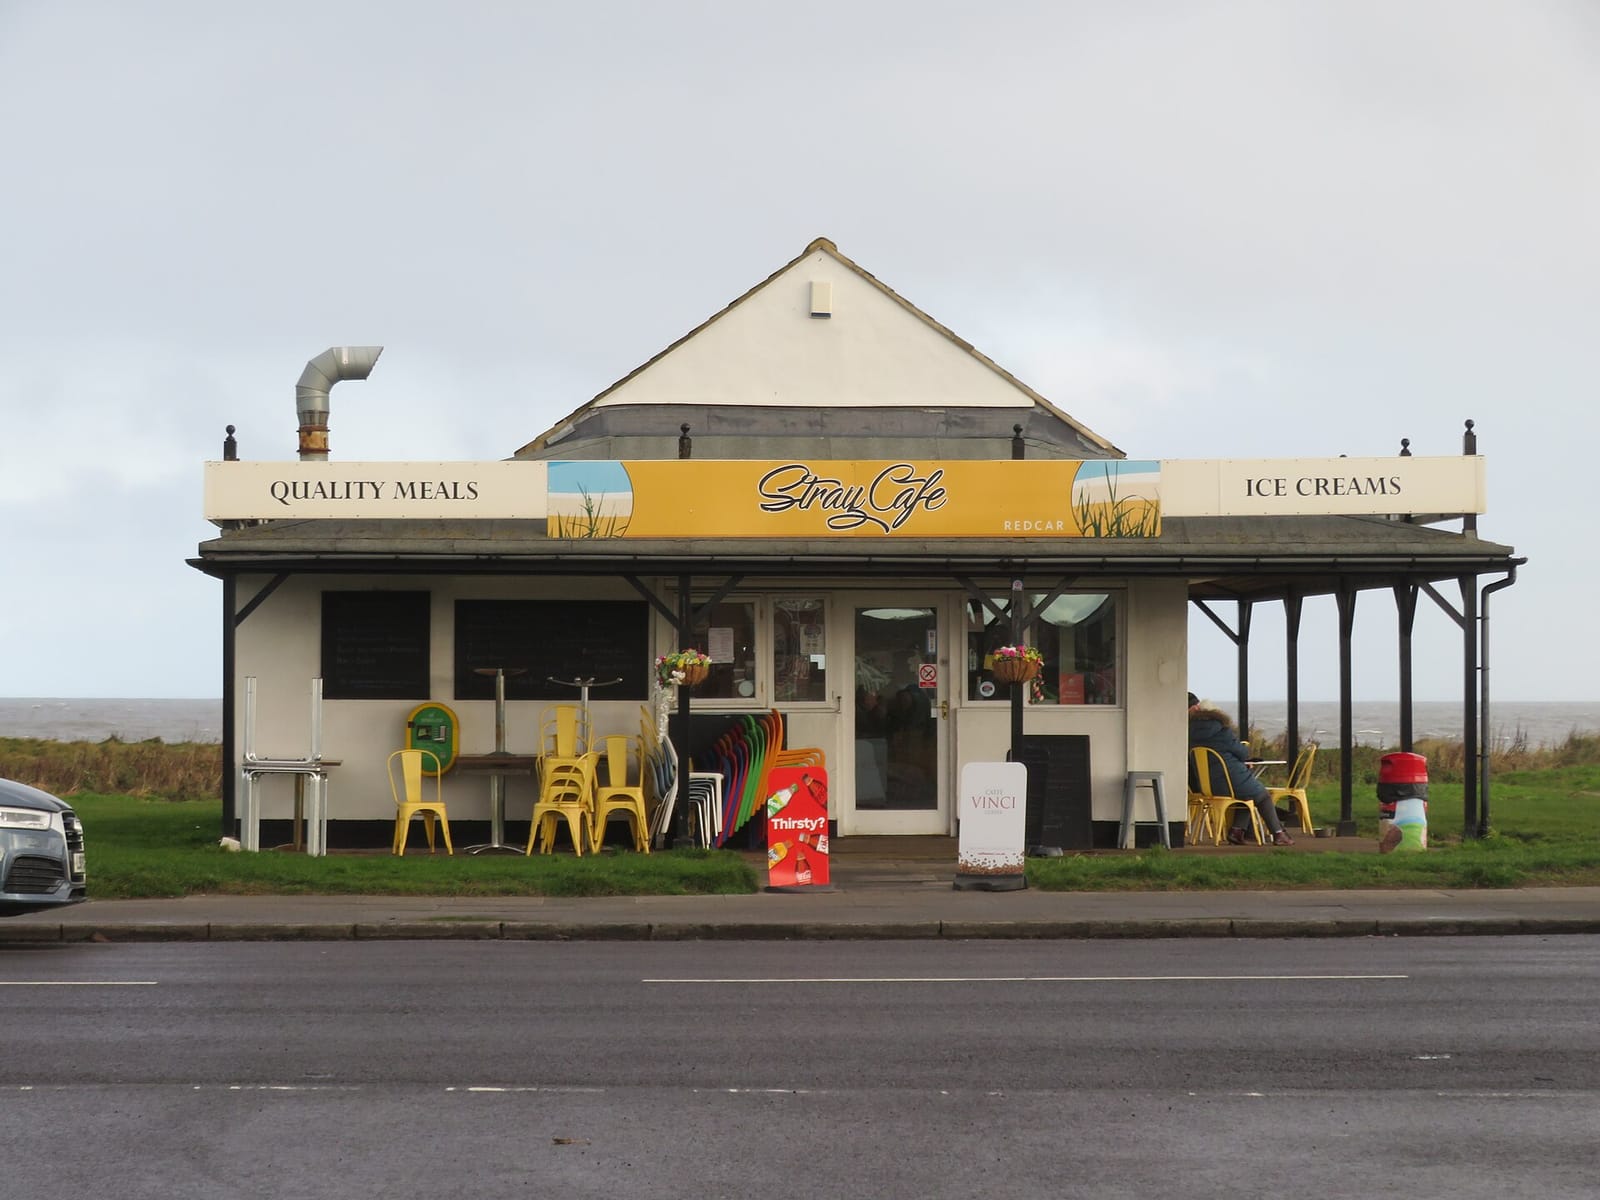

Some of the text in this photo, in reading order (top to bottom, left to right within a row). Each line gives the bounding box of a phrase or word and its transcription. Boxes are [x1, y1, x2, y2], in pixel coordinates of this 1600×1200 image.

[270, 480, 479, 505] QUALITY MEALS
[1246, 476, 1401, 496] ICE CREAMS
[757, 463, 947, 534] Stray Cafe
[1004, 520, 1064, 531] REDCAR
[972, 796, 1016, 809] VINCI
[771, 817, 826, 831] Thirsty?
